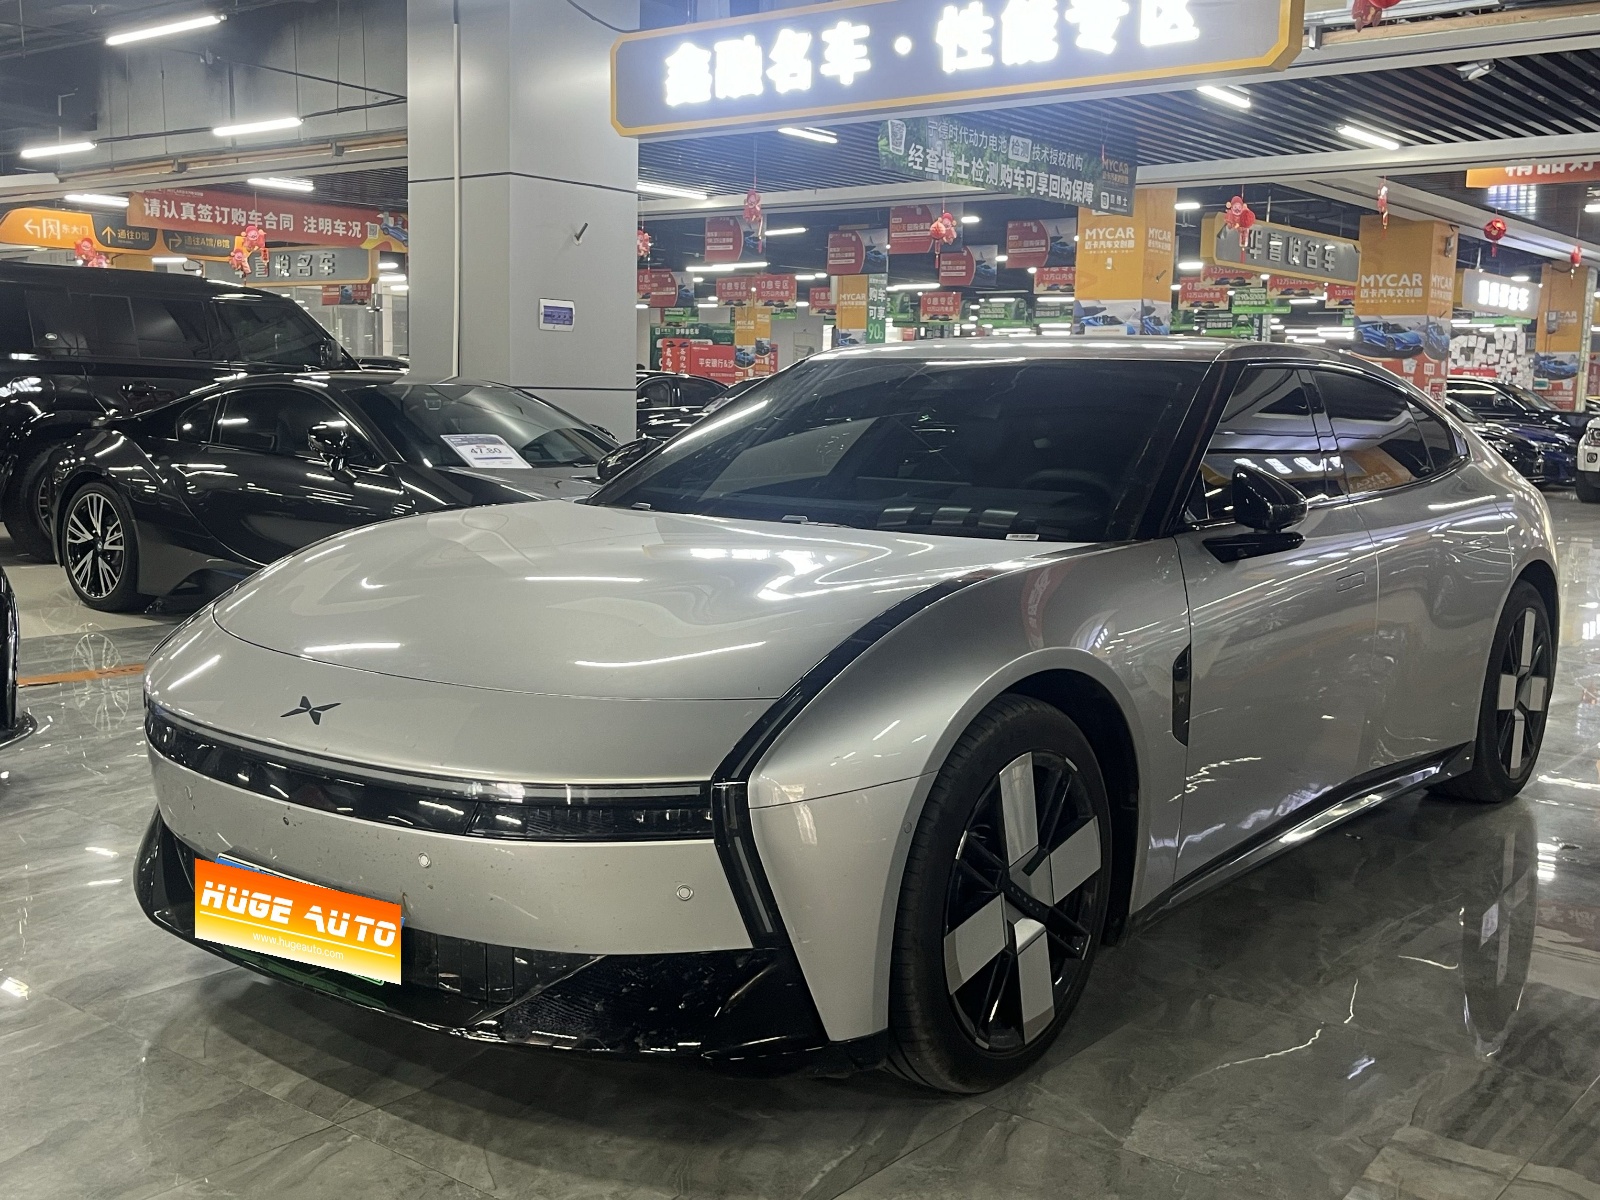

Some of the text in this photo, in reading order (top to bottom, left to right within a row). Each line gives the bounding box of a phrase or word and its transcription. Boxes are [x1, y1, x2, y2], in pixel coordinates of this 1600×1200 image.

[144, 198, 362, 238] 请认真签订购车合同 注明车况
[62, 224, 89, 236] 东大门
[117, 228, 150, 241] 通往D馆
[1085, 227, 1135, 239] MYCAR
[1148, 227, 1171, 242] MYCAR
[184, 236, 230, 249] 通往A馆/B馆
[1085, 239, 1135, 249] 迈卡汽车文创园
[235, 252, 335, 279] 喜悦名车
[1361, 273, 1423, 288] MYCAR
[1431, 274, 1453, 289] MYCAR
[869, 287, 886, 302] 购车
[1361, 288, 1423, 298] 迈卡汽车文创园
[869, 306, 886, 320] 可享
